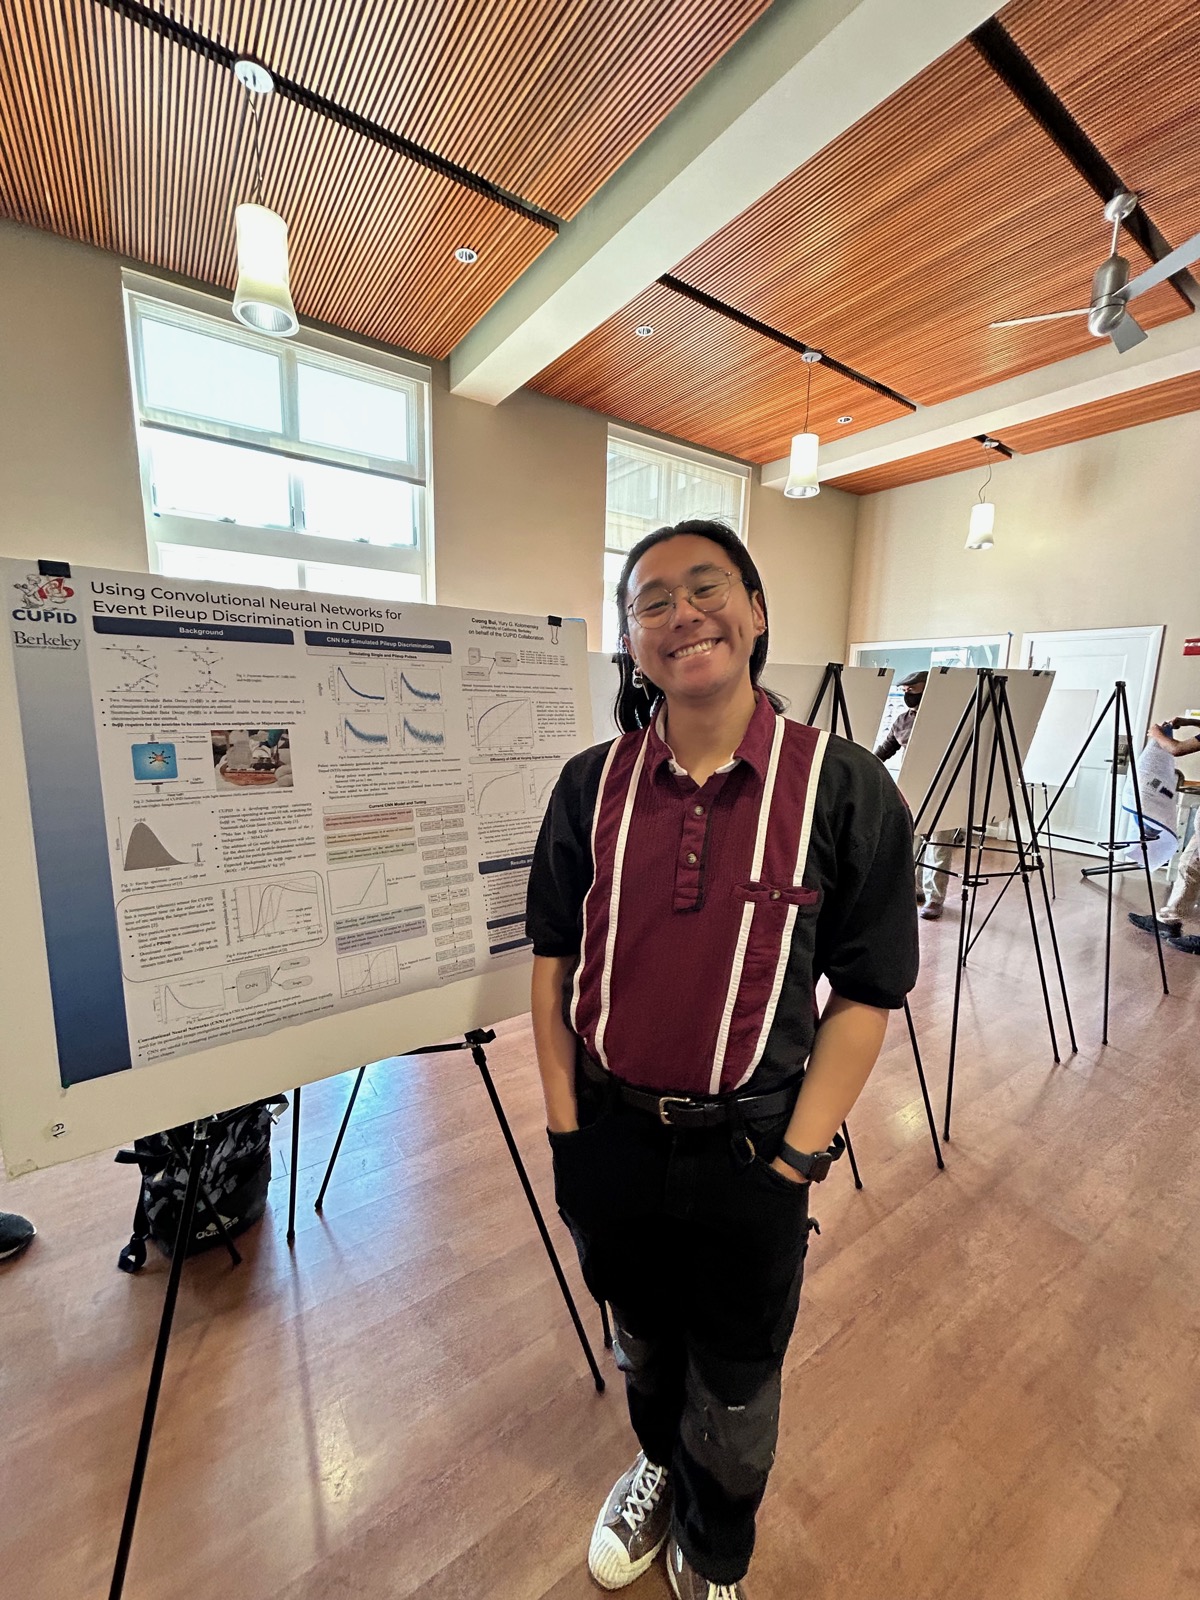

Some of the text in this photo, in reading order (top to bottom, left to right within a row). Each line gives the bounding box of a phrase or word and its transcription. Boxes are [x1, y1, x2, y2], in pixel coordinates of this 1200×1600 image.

[91, 581, 402, 620] Using Convolutional Neural Networks for
[12, 609, 78, 624] CUPID
[93, 600, 385, 634] Event Pileup Discrimination in CUPID
[179, 626, 224, 636] Background
[13, 630, 81, 650] Berkeley
[380, 640, 397, 648] Pileup
[398, 641, 435, 649] Discrimination
